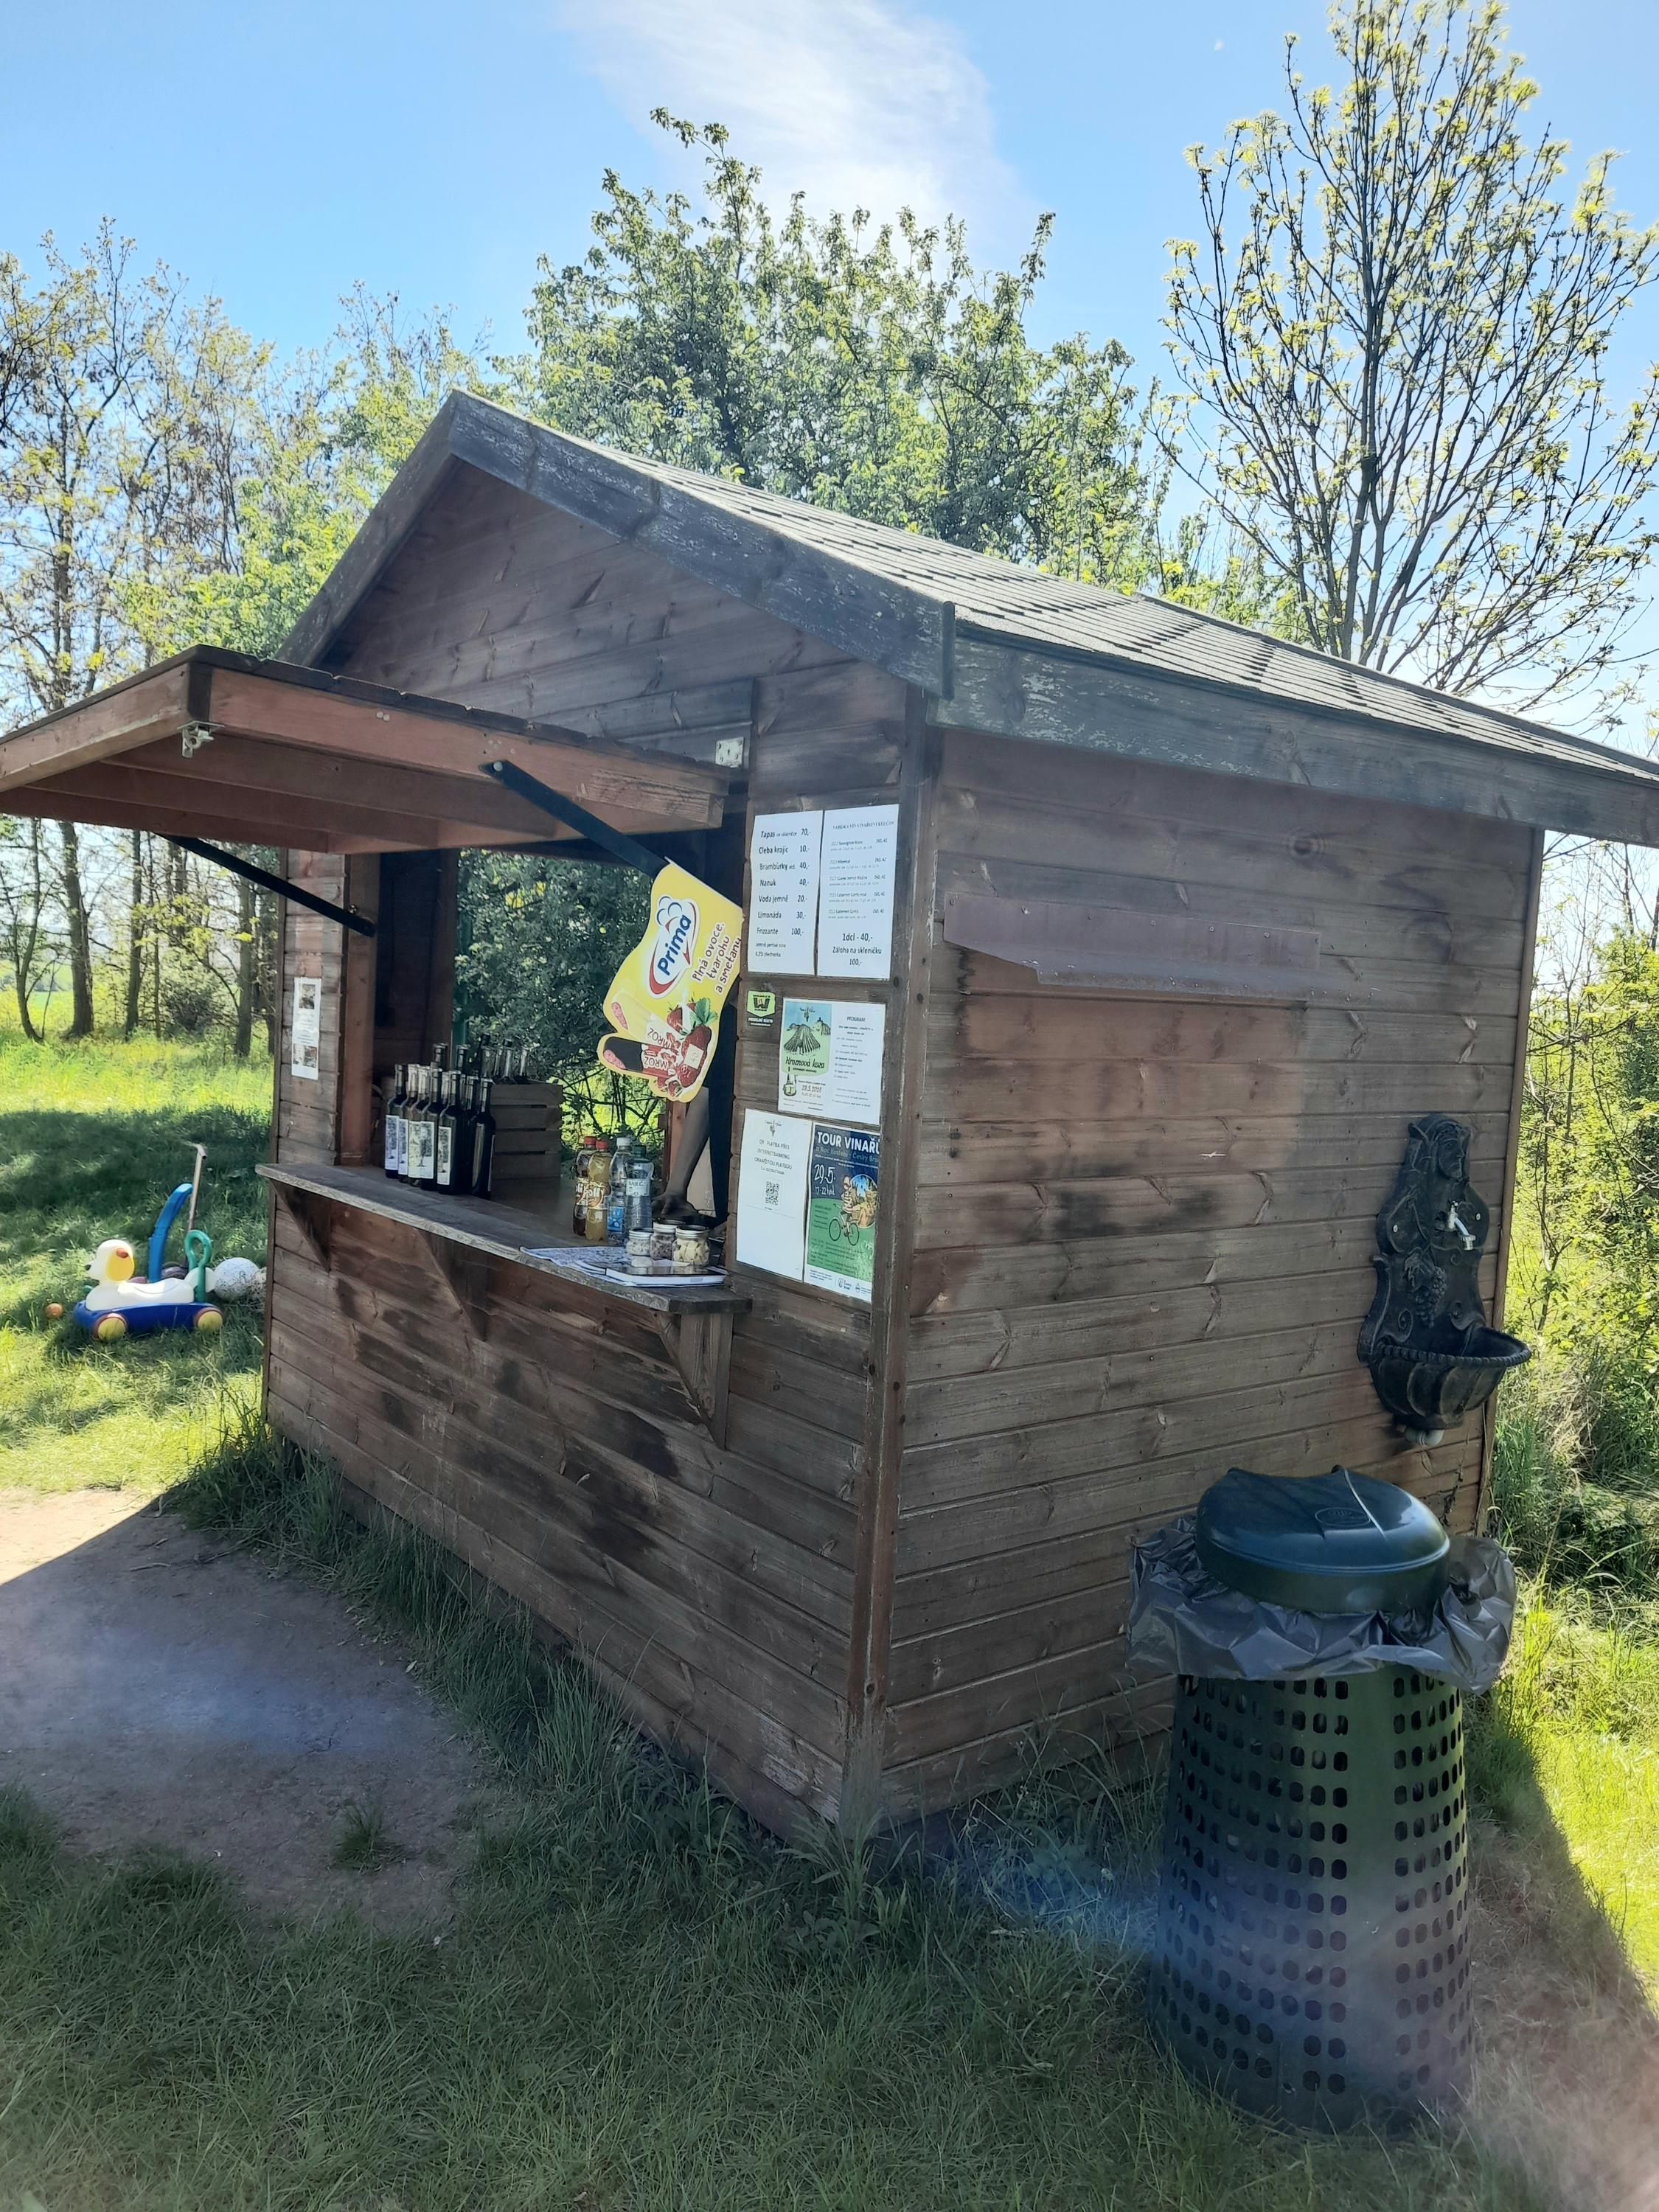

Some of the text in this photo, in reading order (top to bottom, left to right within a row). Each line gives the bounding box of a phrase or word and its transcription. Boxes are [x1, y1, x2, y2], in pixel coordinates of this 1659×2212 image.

[760, 830, 776, 839] Tapas
[801, 828, 811, 836] 70,-
[799, 844, 810, 853] 10,-
[799, 861, 810, 870] 40,-
[759, 878, 810, 886] Nanuk 40,-
[758, 894, 771, 902] Voda
[797, 894, 807, 903] 20,-
[796, 911, 807, 919] 30,-
[791, 928, 804, 936] 100,-
[860, 933, 873, 942] 40,-
[657, 914, 692, 976] Prima
[832, 945, 849, 953] Záloha
[858, 946, 882, 954] skleničku
[706, 936, 730, 979] tvarohu
[849, 958, 863, 966] 100,-
[715, 937, 742, 993] a smetany
[692, 959, 709, 981] Plná
[817, 1131, 842, 1148] TOUR
